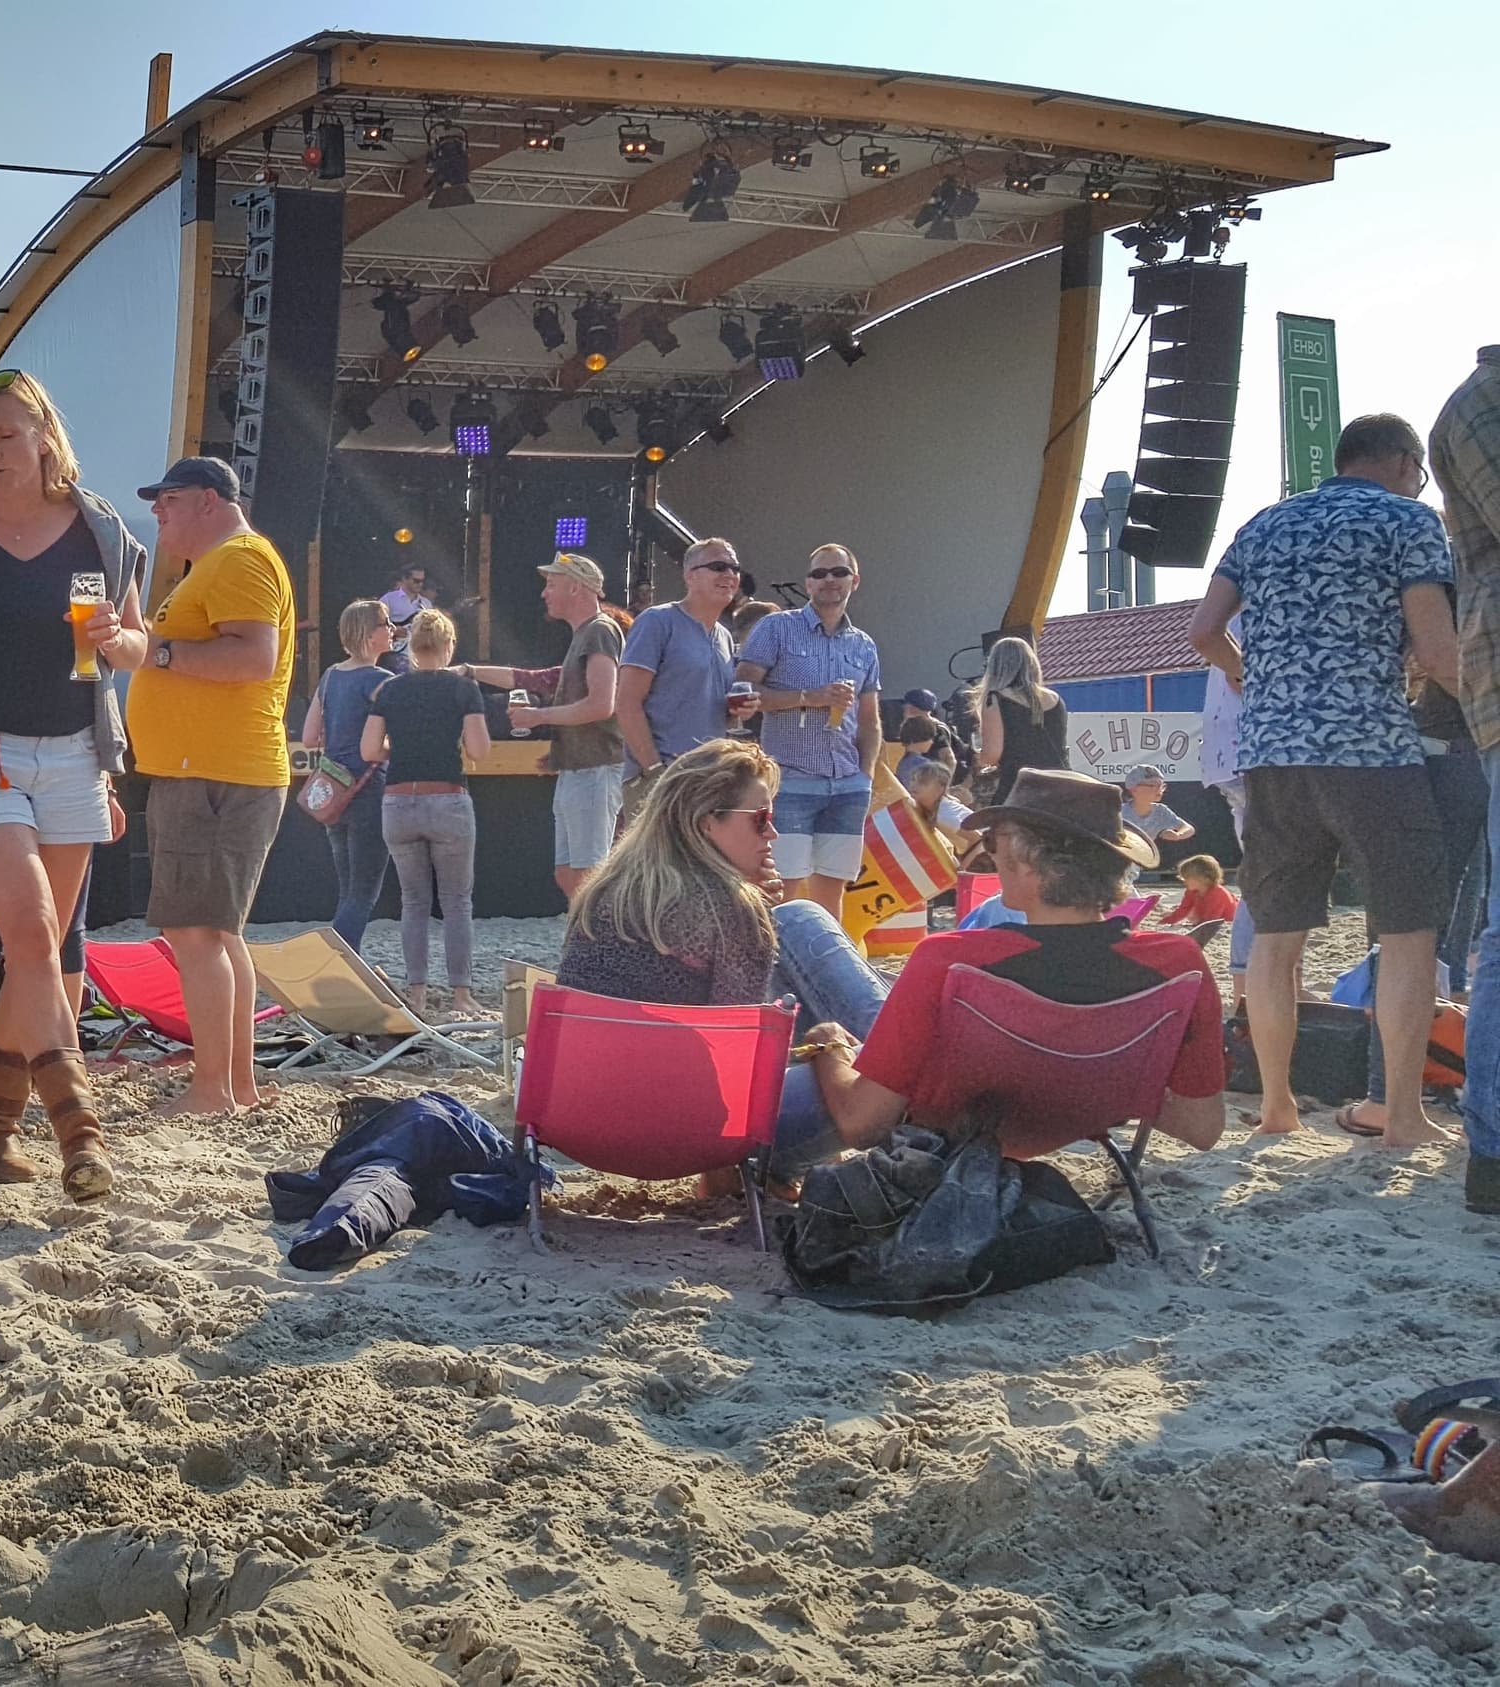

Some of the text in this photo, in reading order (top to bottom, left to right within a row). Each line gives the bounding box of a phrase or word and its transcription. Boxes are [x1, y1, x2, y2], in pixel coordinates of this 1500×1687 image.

[1293, 338, 1323, 356] EHBO
[1075, 718, 1189, 765] EHBO
[1095, 763, 1176, 775] TERSCNG
